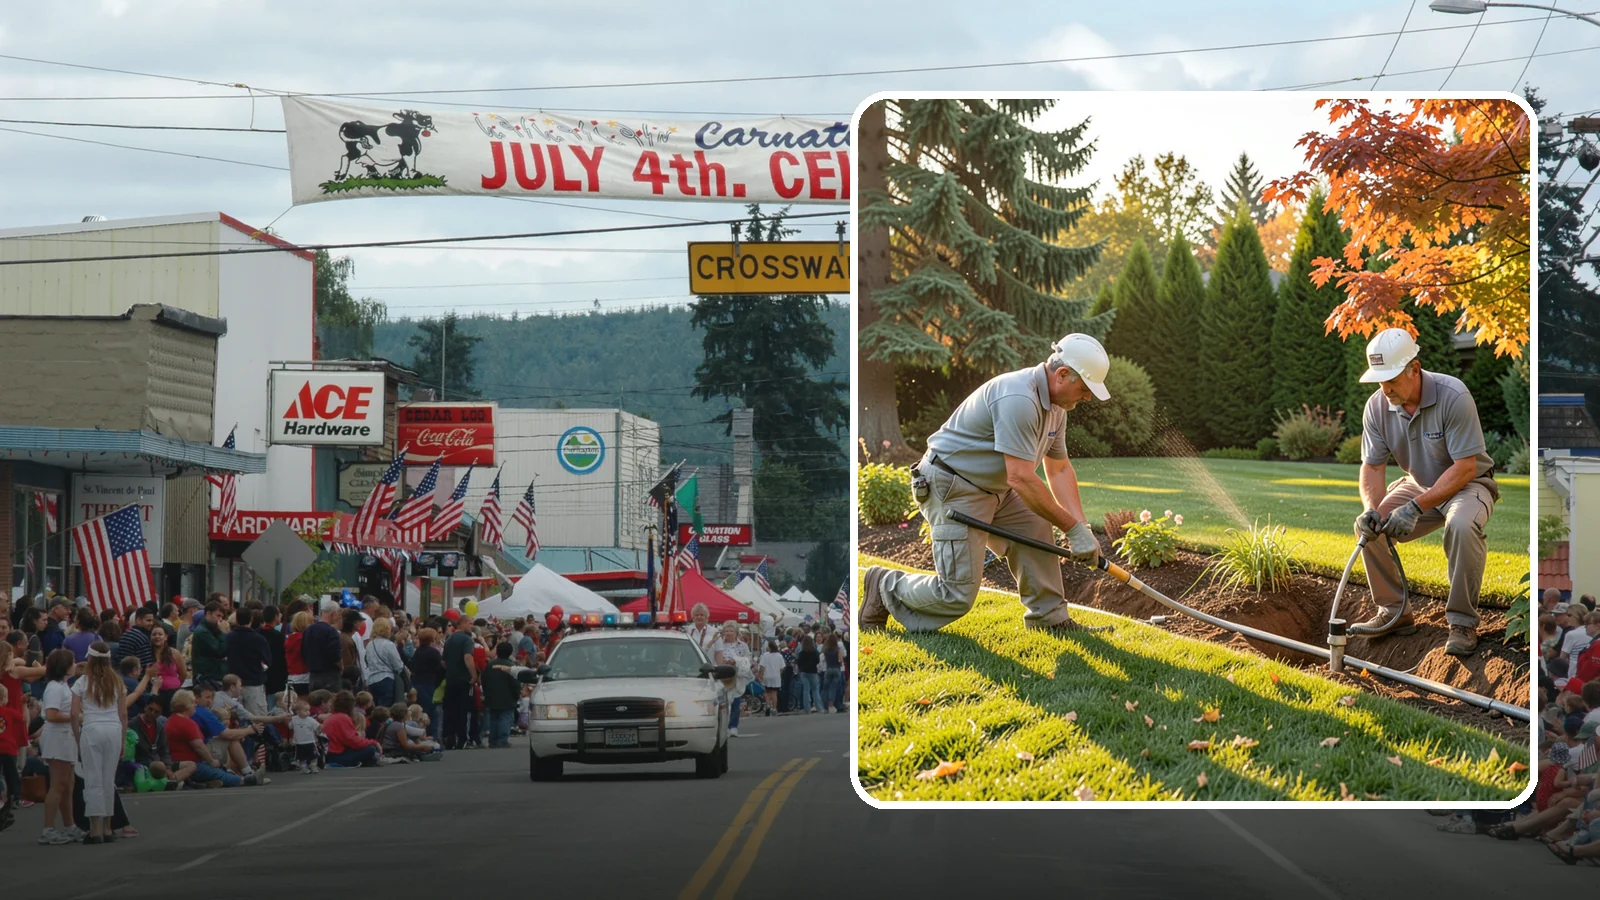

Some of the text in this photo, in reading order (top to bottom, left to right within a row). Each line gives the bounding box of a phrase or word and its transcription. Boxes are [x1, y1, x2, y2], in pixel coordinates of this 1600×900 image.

[481, 141, 605, 192] JULY
[632, 150, 746, 198] 4th.
[697, 254, 850, 280] CROSSWA
[283, 380, 373, 420] ACE
[405, 409, 452, 422] CEDAR
[283, 421, 371, 437] Hardware
[416, 428, 477, 447] Coca-Cola
[83, 484, 155, 495] St. Vincent de Paul
[212, 516, 331, 535] HARDARE
[688, 526, 742, 535] CRNATION
[699, 535, 731, 543] GLASS
